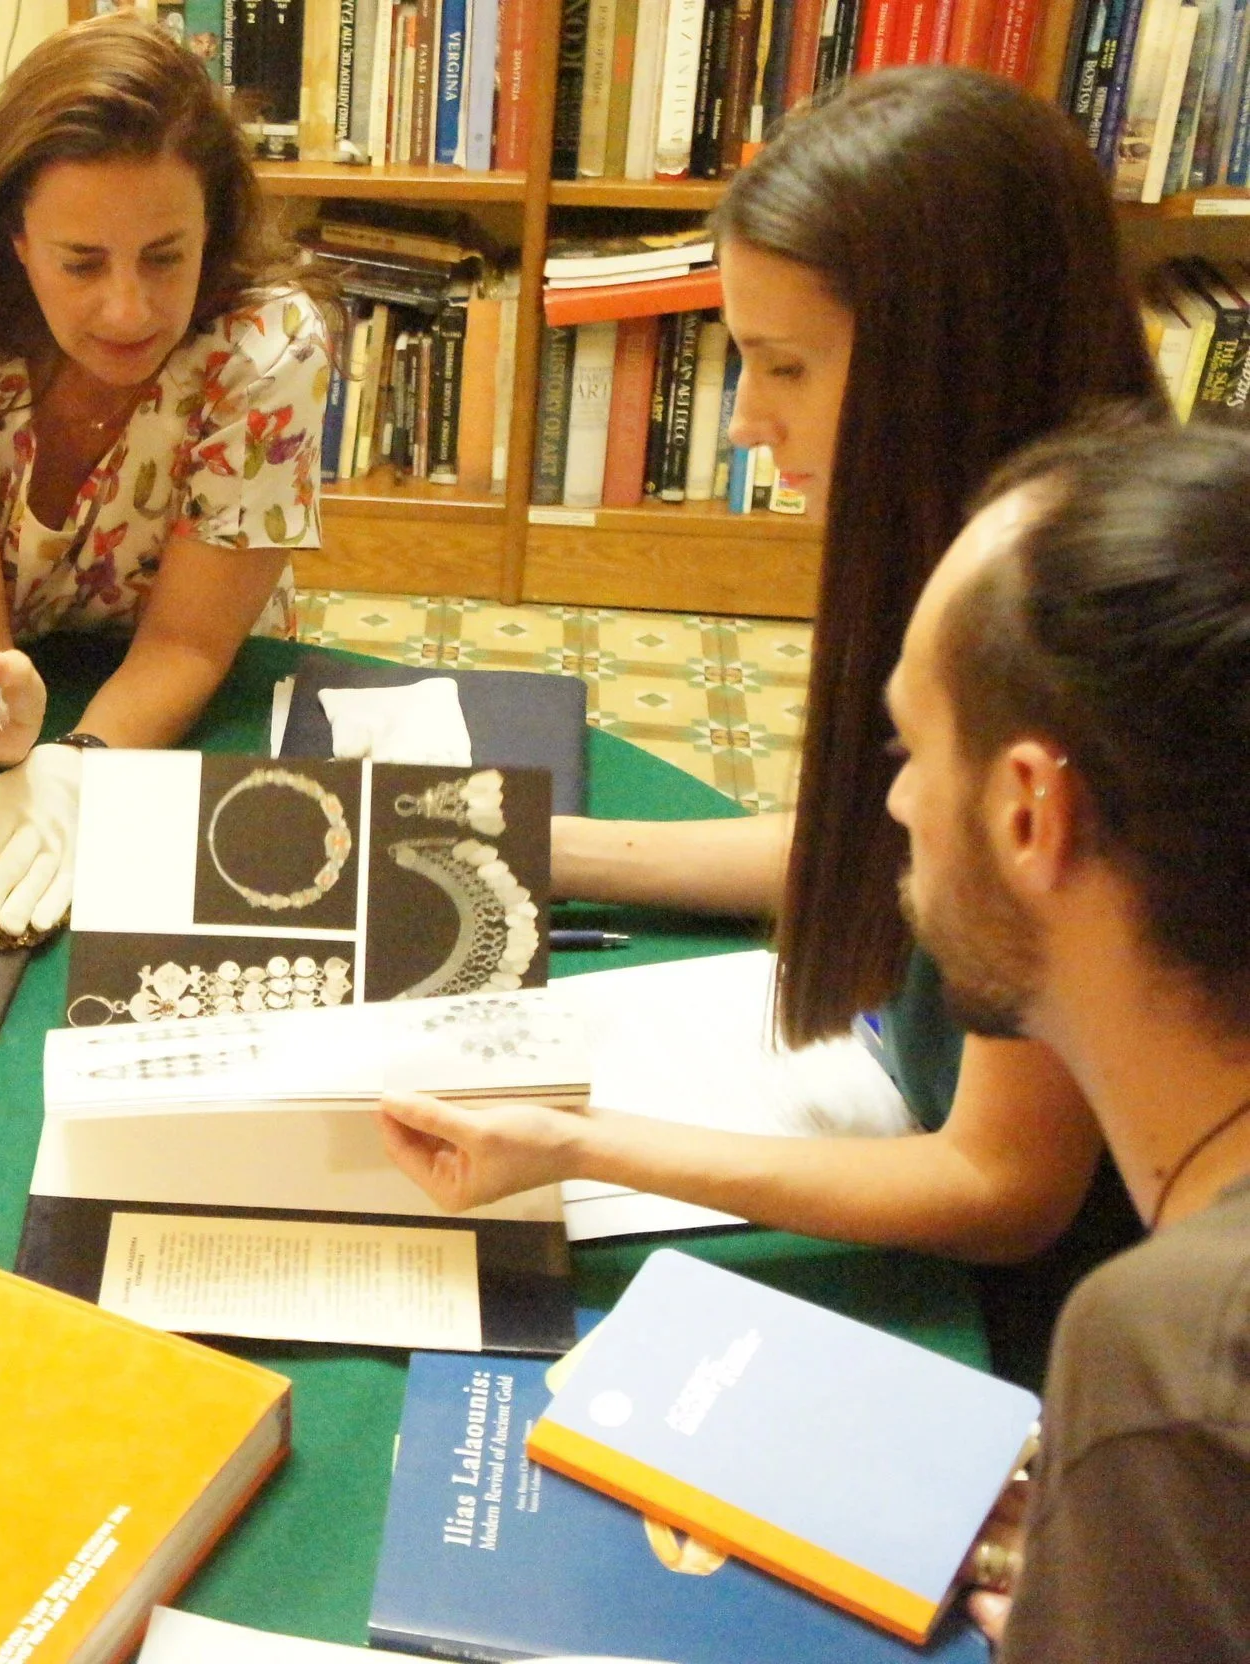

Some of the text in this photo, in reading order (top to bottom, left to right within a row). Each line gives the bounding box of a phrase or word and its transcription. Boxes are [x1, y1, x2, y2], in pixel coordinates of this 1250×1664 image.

[444, 31, 462, 102] VERGINA
[1078, 59, 1098, 113] BOSTON
[444, 1372, 490, 1546] Ilias Lalaounis:
[479, 1376, 513, 1550] Modern Revival of Ancient Gold
